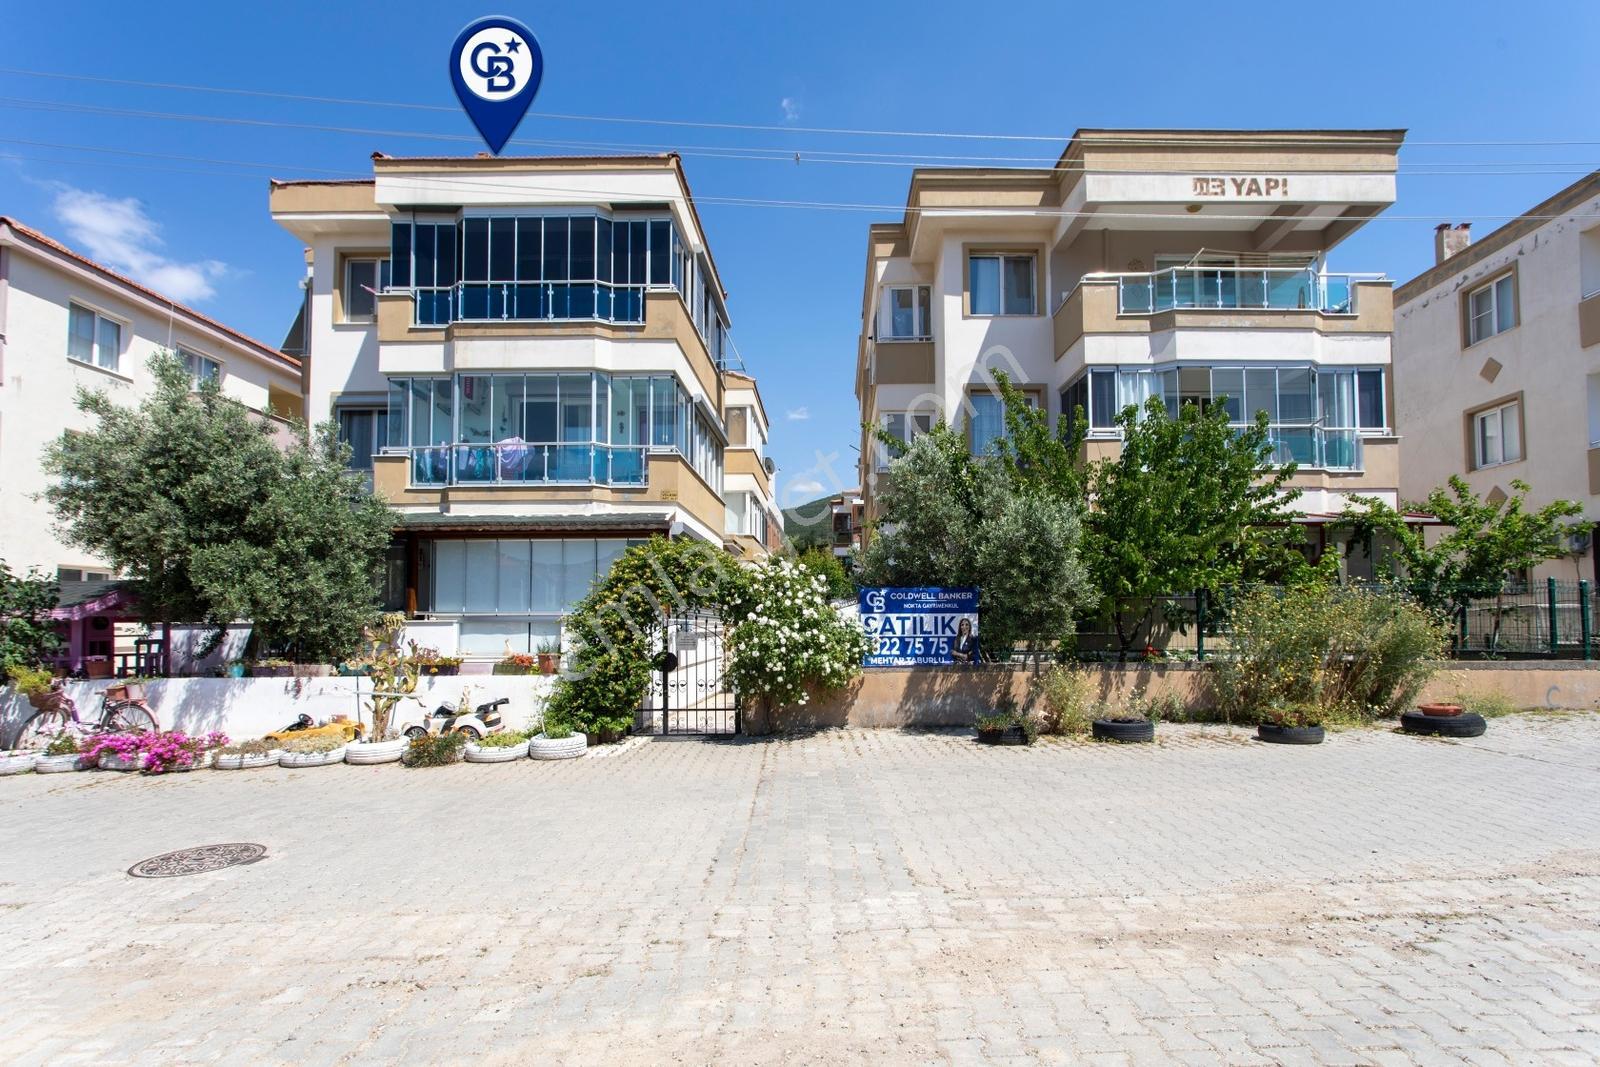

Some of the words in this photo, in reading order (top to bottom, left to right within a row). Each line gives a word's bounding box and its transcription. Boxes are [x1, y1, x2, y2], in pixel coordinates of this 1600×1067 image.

[890, 592, 936, 600] COLDWELL
[938, 592, 973, 600] BANKER
[864, 616, 957, 636] SATILIK
[904, 637, 925, 655] 75
[929, 637, 949, 655] 75
[905, 656, 945, 664] TABURLU
